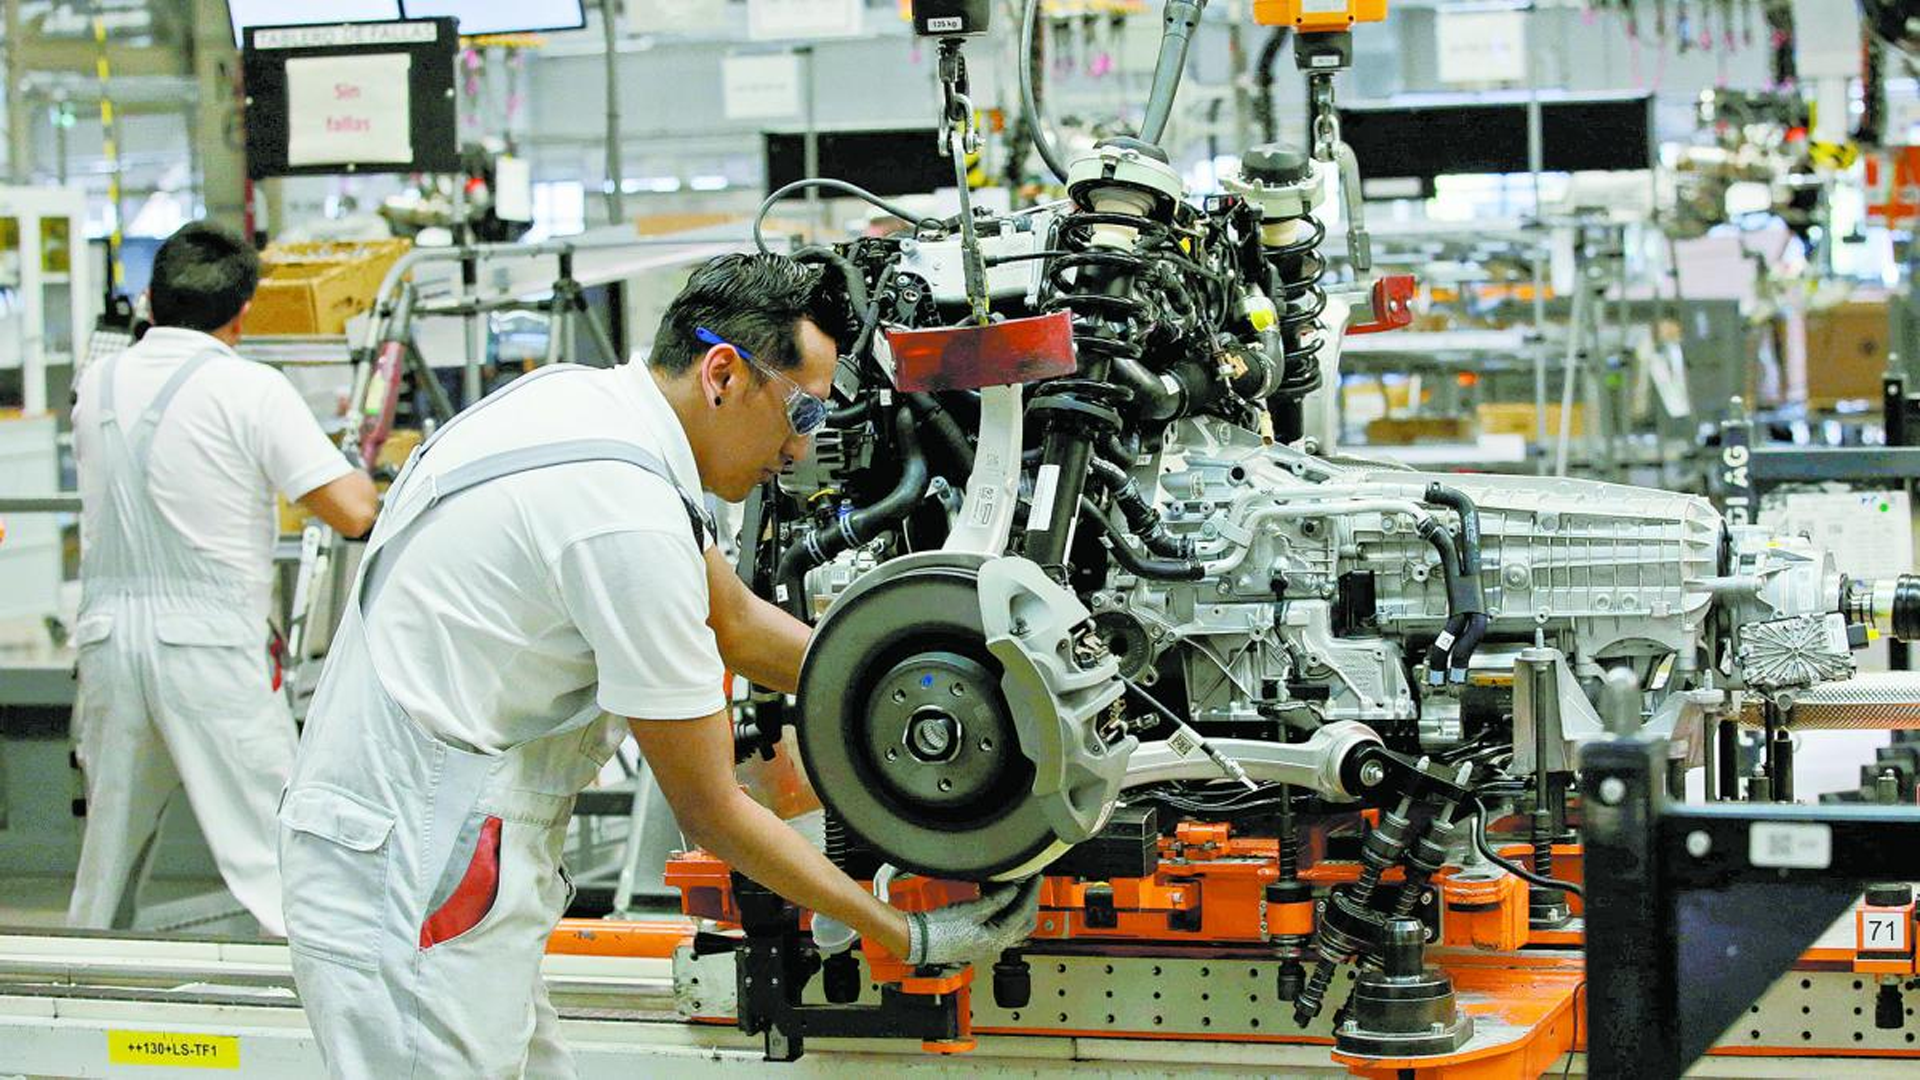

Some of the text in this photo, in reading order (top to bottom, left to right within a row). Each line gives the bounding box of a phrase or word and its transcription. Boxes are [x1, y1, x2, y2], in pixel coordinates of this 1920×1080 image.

[334, 83, 360, 101] Sin
[1723, 445, 1749, 488] AG
[1868, 920, 1894, 941] 71
[128, 1042, 218, 1057] ++130+LS-TF1
